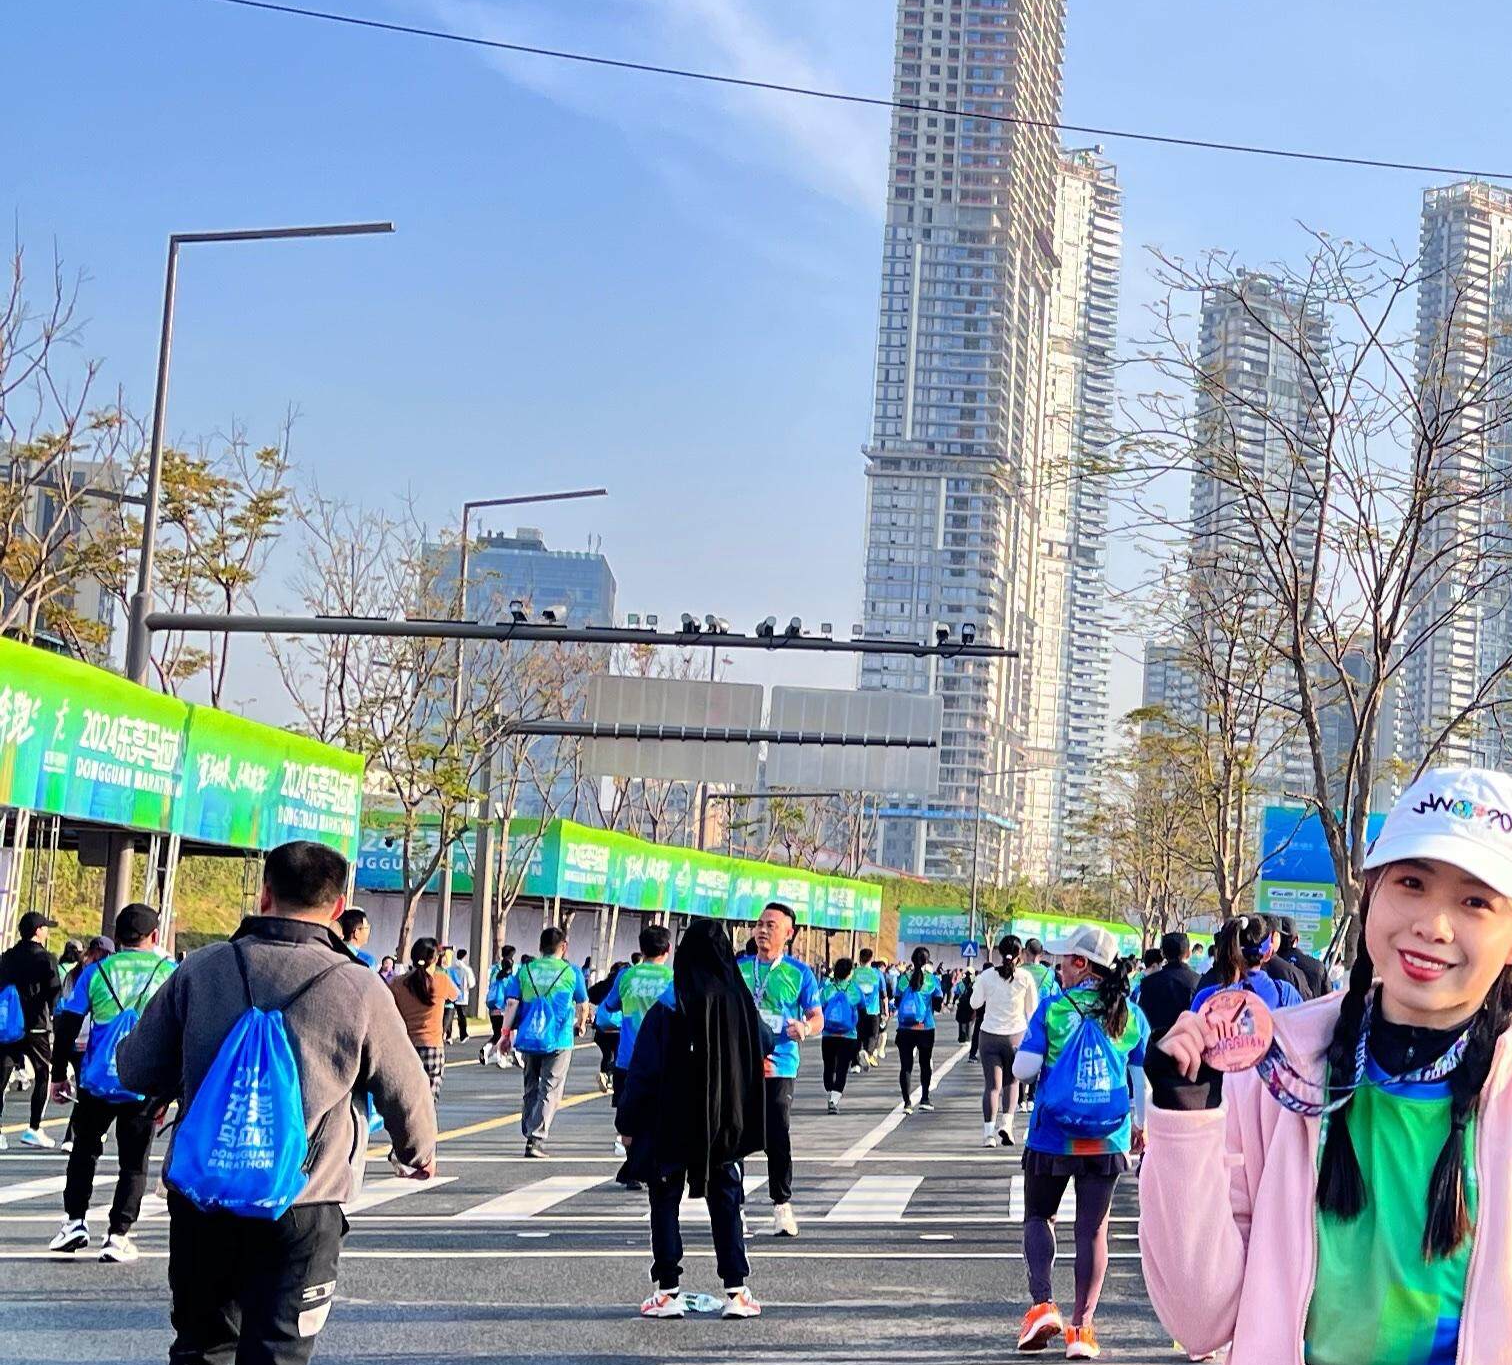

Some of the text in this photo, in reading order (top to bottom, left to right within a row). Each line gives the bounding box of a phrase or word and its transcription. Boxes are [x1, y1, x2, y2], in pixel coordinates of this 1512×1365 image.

[79, 708, 183, 775] 2024东莞马拉
[207, 1157, 274, 1170] MARATHON
